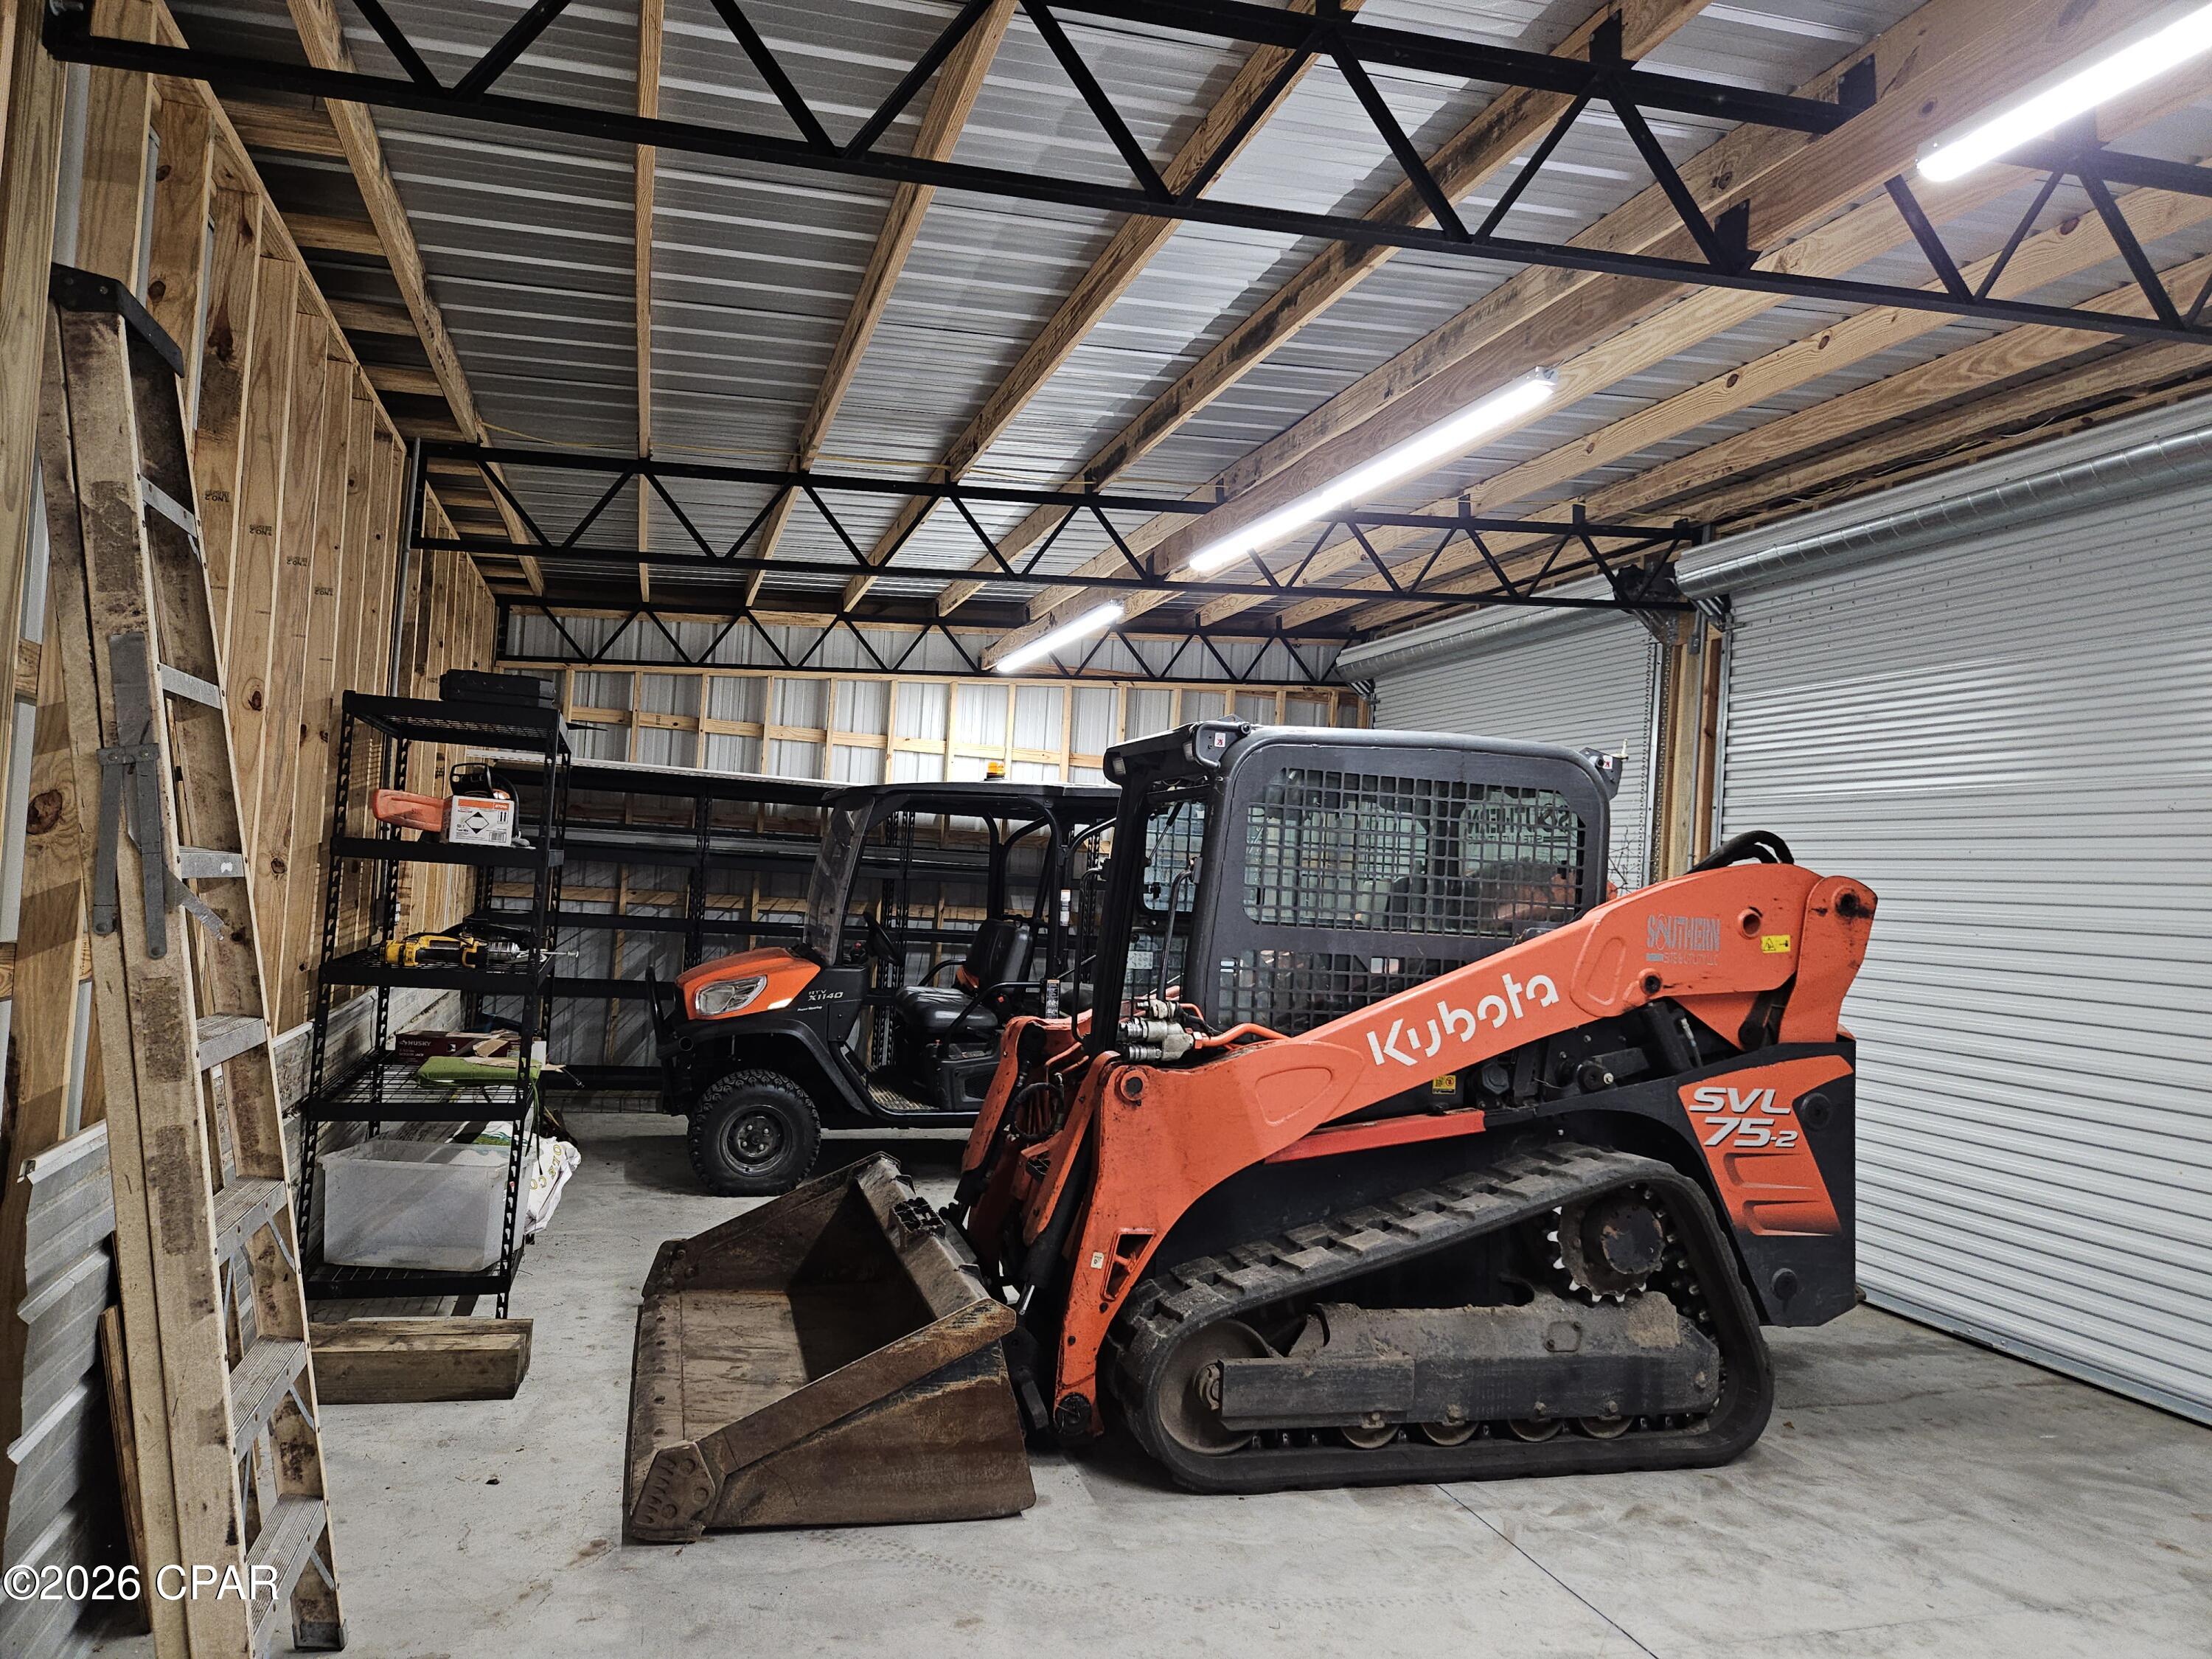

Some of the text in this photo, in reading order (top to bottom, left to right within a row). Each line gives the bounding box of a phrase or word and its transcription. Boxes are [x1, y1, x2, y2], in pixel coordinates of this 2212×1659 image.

[1646, 914, 1721, 951] SOUTHERN
[808, 992, 844, 1001] X1140
[1366, 973, 1559, 1066] Kubota
[1688, 1087, 1791, 1115] SVL
[1704, 1116, 1799, 1148] 75-2
